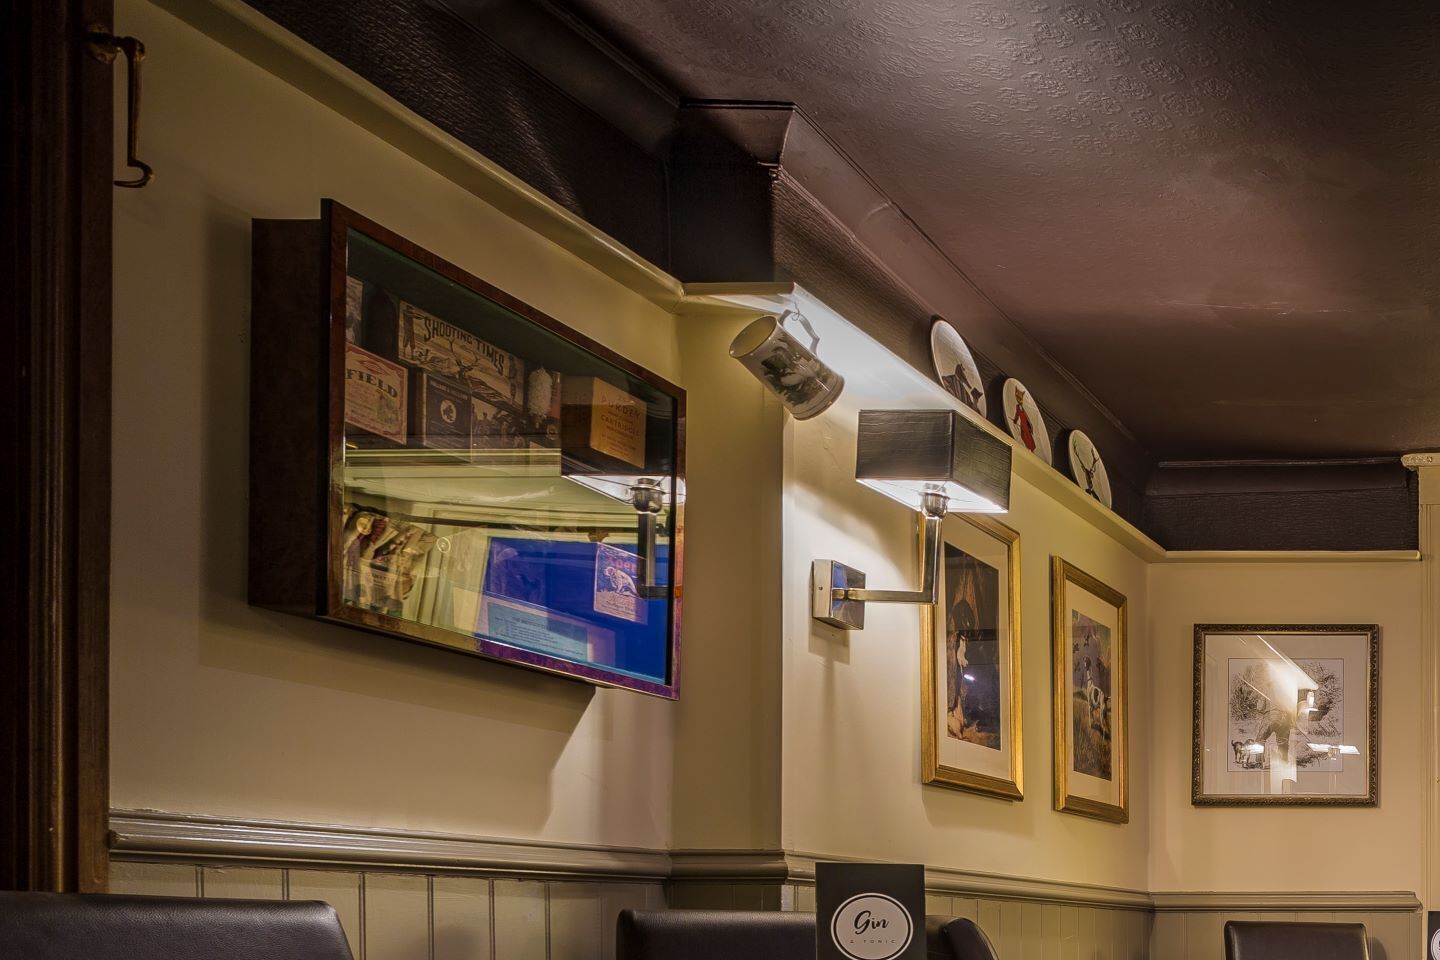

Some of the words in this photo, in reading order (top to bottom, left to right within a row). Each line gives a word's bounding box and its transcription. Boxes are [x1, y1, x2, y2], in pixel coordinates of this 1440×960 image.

[423, 315, 473, 345] SHOOTING
[475, 338, 505, 376] TIMES
[345, 368, 398, 398] FIELD
[854, 910, 889, 935] Gin
